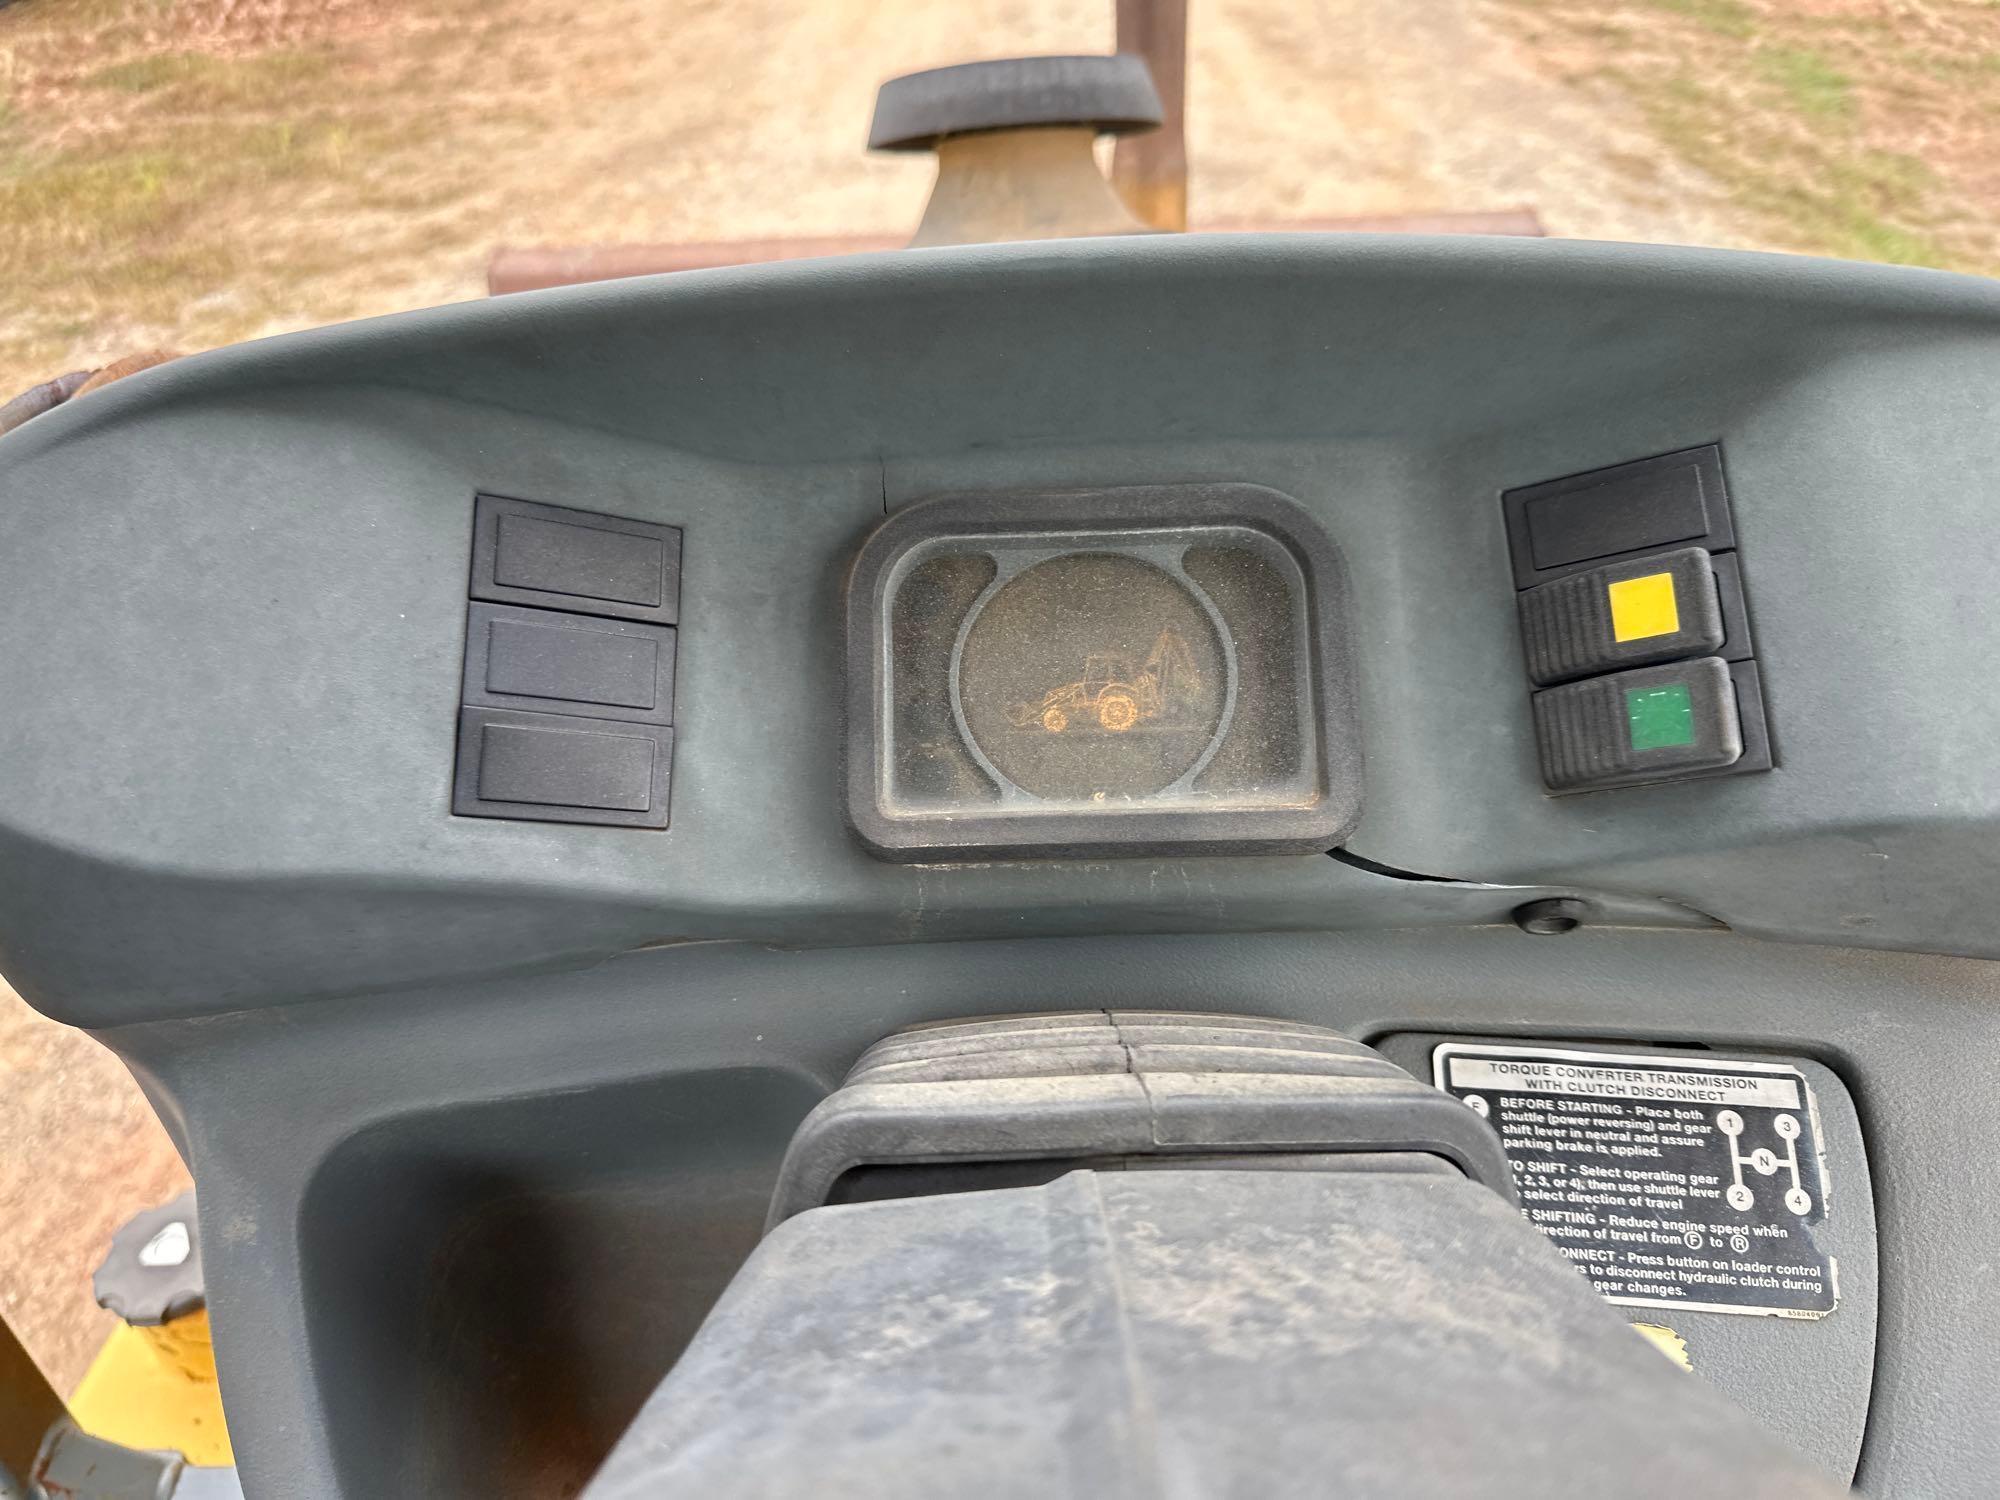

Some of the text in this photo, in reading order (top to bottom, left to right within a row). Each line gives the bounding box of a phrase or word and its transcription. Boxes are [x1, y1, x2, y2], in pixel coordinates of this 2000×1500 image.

[1490, 1063, 1758, 1090] TORQUE CONVERTER TRANSMISSION
[1525, 1079, 1725, 1101] WITH CLUTCH DISCONNECT
[1500, 1097, 1555, 1110] BEFORE
[1557, 1102, 1622, 1115] STARTING
[1635, 1106, 1671, 1118] Place
[1674, 1108, 1704, 1120] both
[1501, 1111, 1712, 1136] shuttle (power reversing) and gear
[1502, 1124, 1704, 1147] shift lever in neutral and assure
[1504, 1137, 1664, 1158] parking brake is applied.
[1528, 1162, 1568, 1174] SHIFT
[1580, 1165, 1621, 1178] Select
[1624, 1170, 1686, 1184] operating
[1690, 1174, 1719, 1186] gear
[1524, 1189, 1564, 1201] select
[1567, 1191, 1626, 1204] direction
[1629, 1196, 1643, 1206] of
[1646, 1197, 1684, 1210] travel
[1554, 1178, 1566, 1188] or
[1588, 1180, 1616, 1191] then
[1618, 1183, 1641, 1193] use
[1644, 1184, 1686, 1196] shuttle
[1690, 1186, 1721, 1198] lever
[1532, 1208, 1596, 1224] SHIFTING
[1609, 1214, 1658, 1228] Reduce
[1662, 1220, 1706, 1232] engine
[1710, 1224, 1749, 1236] speed
[1752, 1226, 1788, 1238] when
[1594, 1229, 1607, 1240] of
[1610, 1229, 1648, 1242] travel
[1651, 1231, 1682, 1244] from
[1710, 1236, 1724, 1248] to
[1628, 1252, 1664, 1266] Press
[1666, 1255, 1709, 1268] button
[1712, 1260, 1728, 1271] on
[1732, 1262, 1773, 1274] loader
[1776, 1265, 1821, 1277] control
[1590, 1264, 1602, 1276] to
[1606, 1266, 1676, 1280] disconnect
[1679, 1270, 1737, 1285] hydraulic
[1740, 1275, 1780, 1288] clutch
[1782, 1278, 1822, 1294] during
[1594, 1280, 1687, 1296] gear changes.
